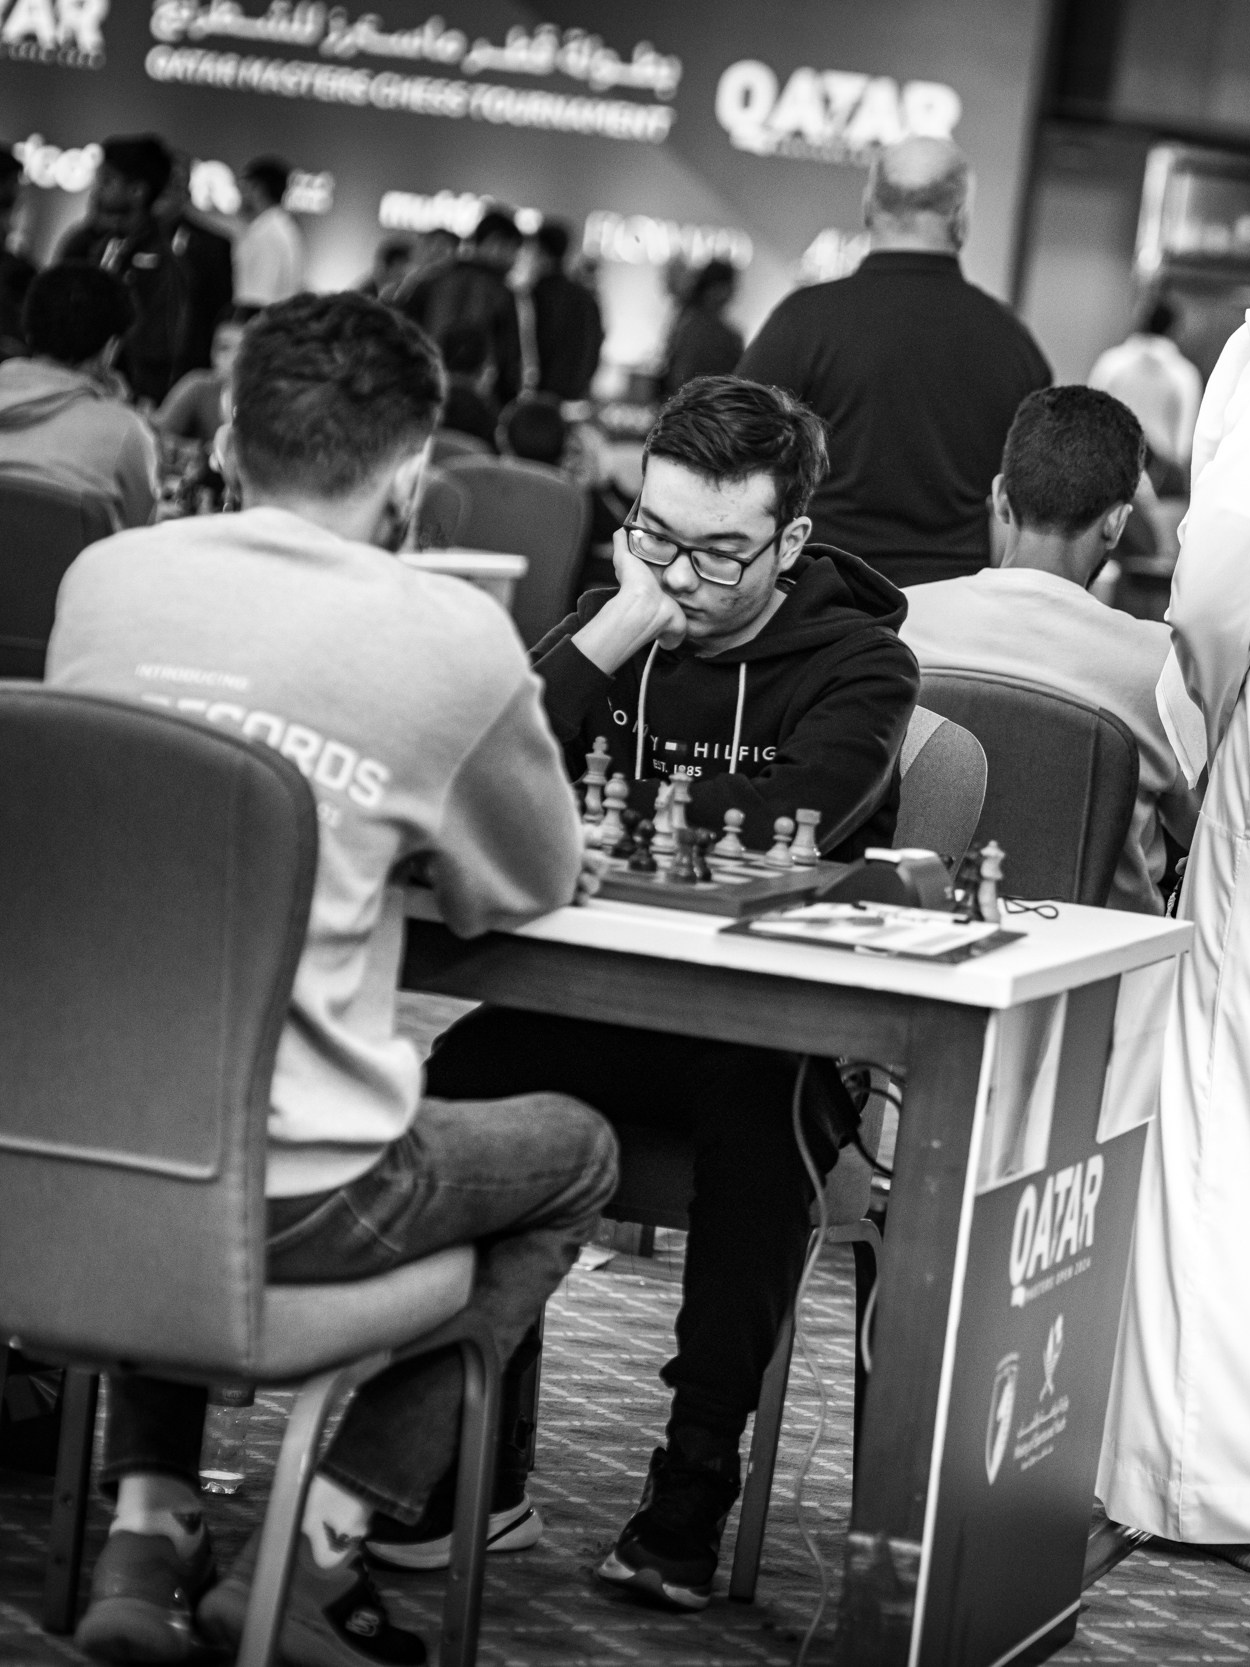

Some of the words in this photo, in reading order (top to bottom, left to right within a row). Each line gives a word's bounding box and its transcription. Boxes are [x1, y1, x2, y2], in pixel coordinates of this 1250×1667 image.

[714, 58, 962, 157] QATAR
[140, 692, 392, 809] ORDS
[693, 741, 777, 763] HILFIG
[1009, 1153, 1104, 1308] QATAR
